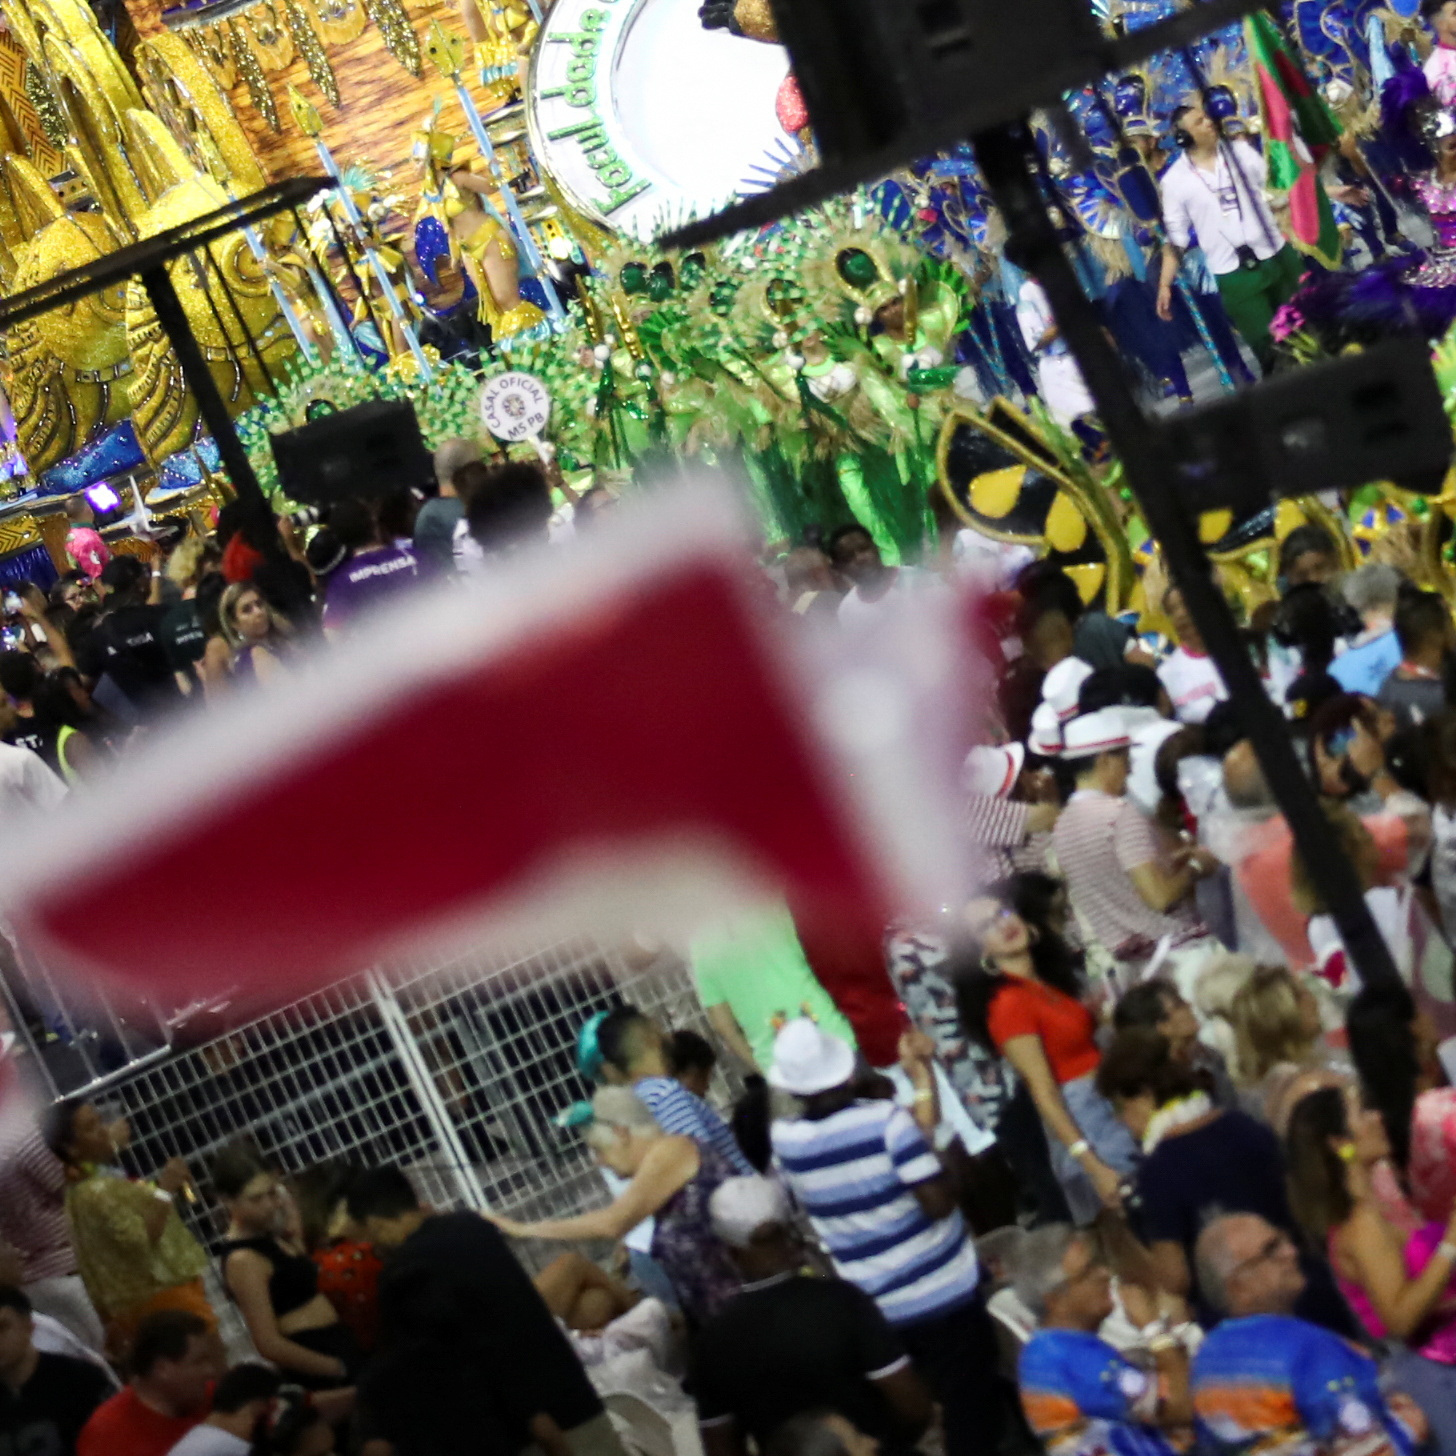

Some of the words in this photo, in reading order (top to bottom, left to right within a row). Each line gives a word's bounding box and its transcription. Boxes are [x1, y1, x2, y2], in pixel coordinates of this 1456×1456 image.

[539, 8, 652, 216] Faculdade
[484, 389, 501, 429] CASAL
[499, 377, 543, 404] OFICIAL
[507, 422, 527, 440] MS
[527, 412, 544, 427] PB
